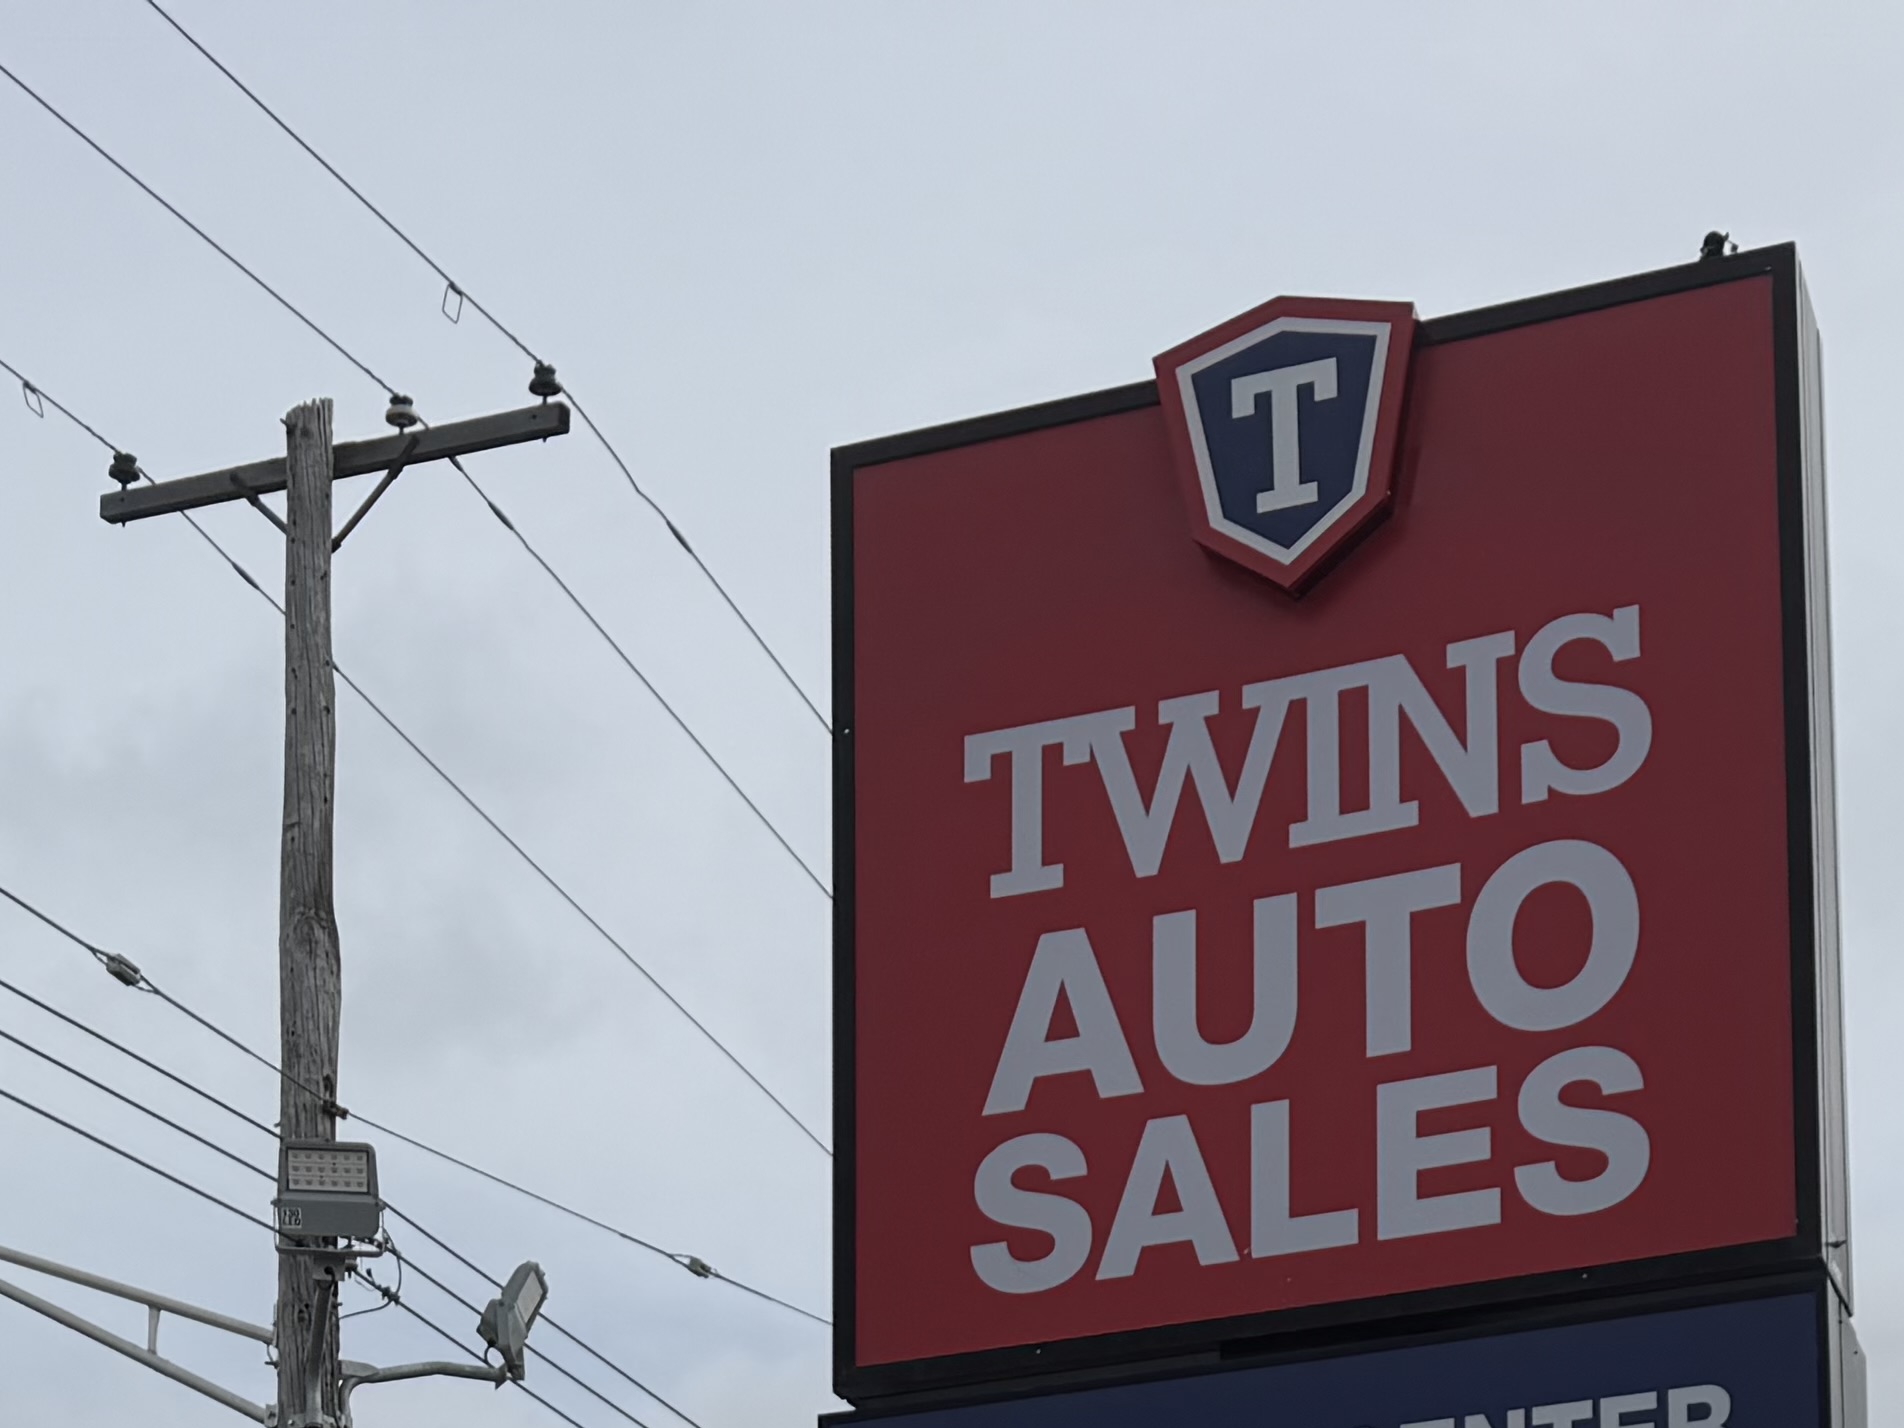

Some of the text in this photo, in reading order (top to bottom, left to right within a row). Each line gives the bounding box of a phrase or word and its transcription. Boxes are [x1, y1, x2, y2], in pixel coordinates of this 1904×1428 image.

[1230, 356, 1339, 514] T
[962, 603, 1654, 900] TWINS
[981, 838, 1641, 1117] AUTO
[968, 1044, 1652, 1294] SALES
